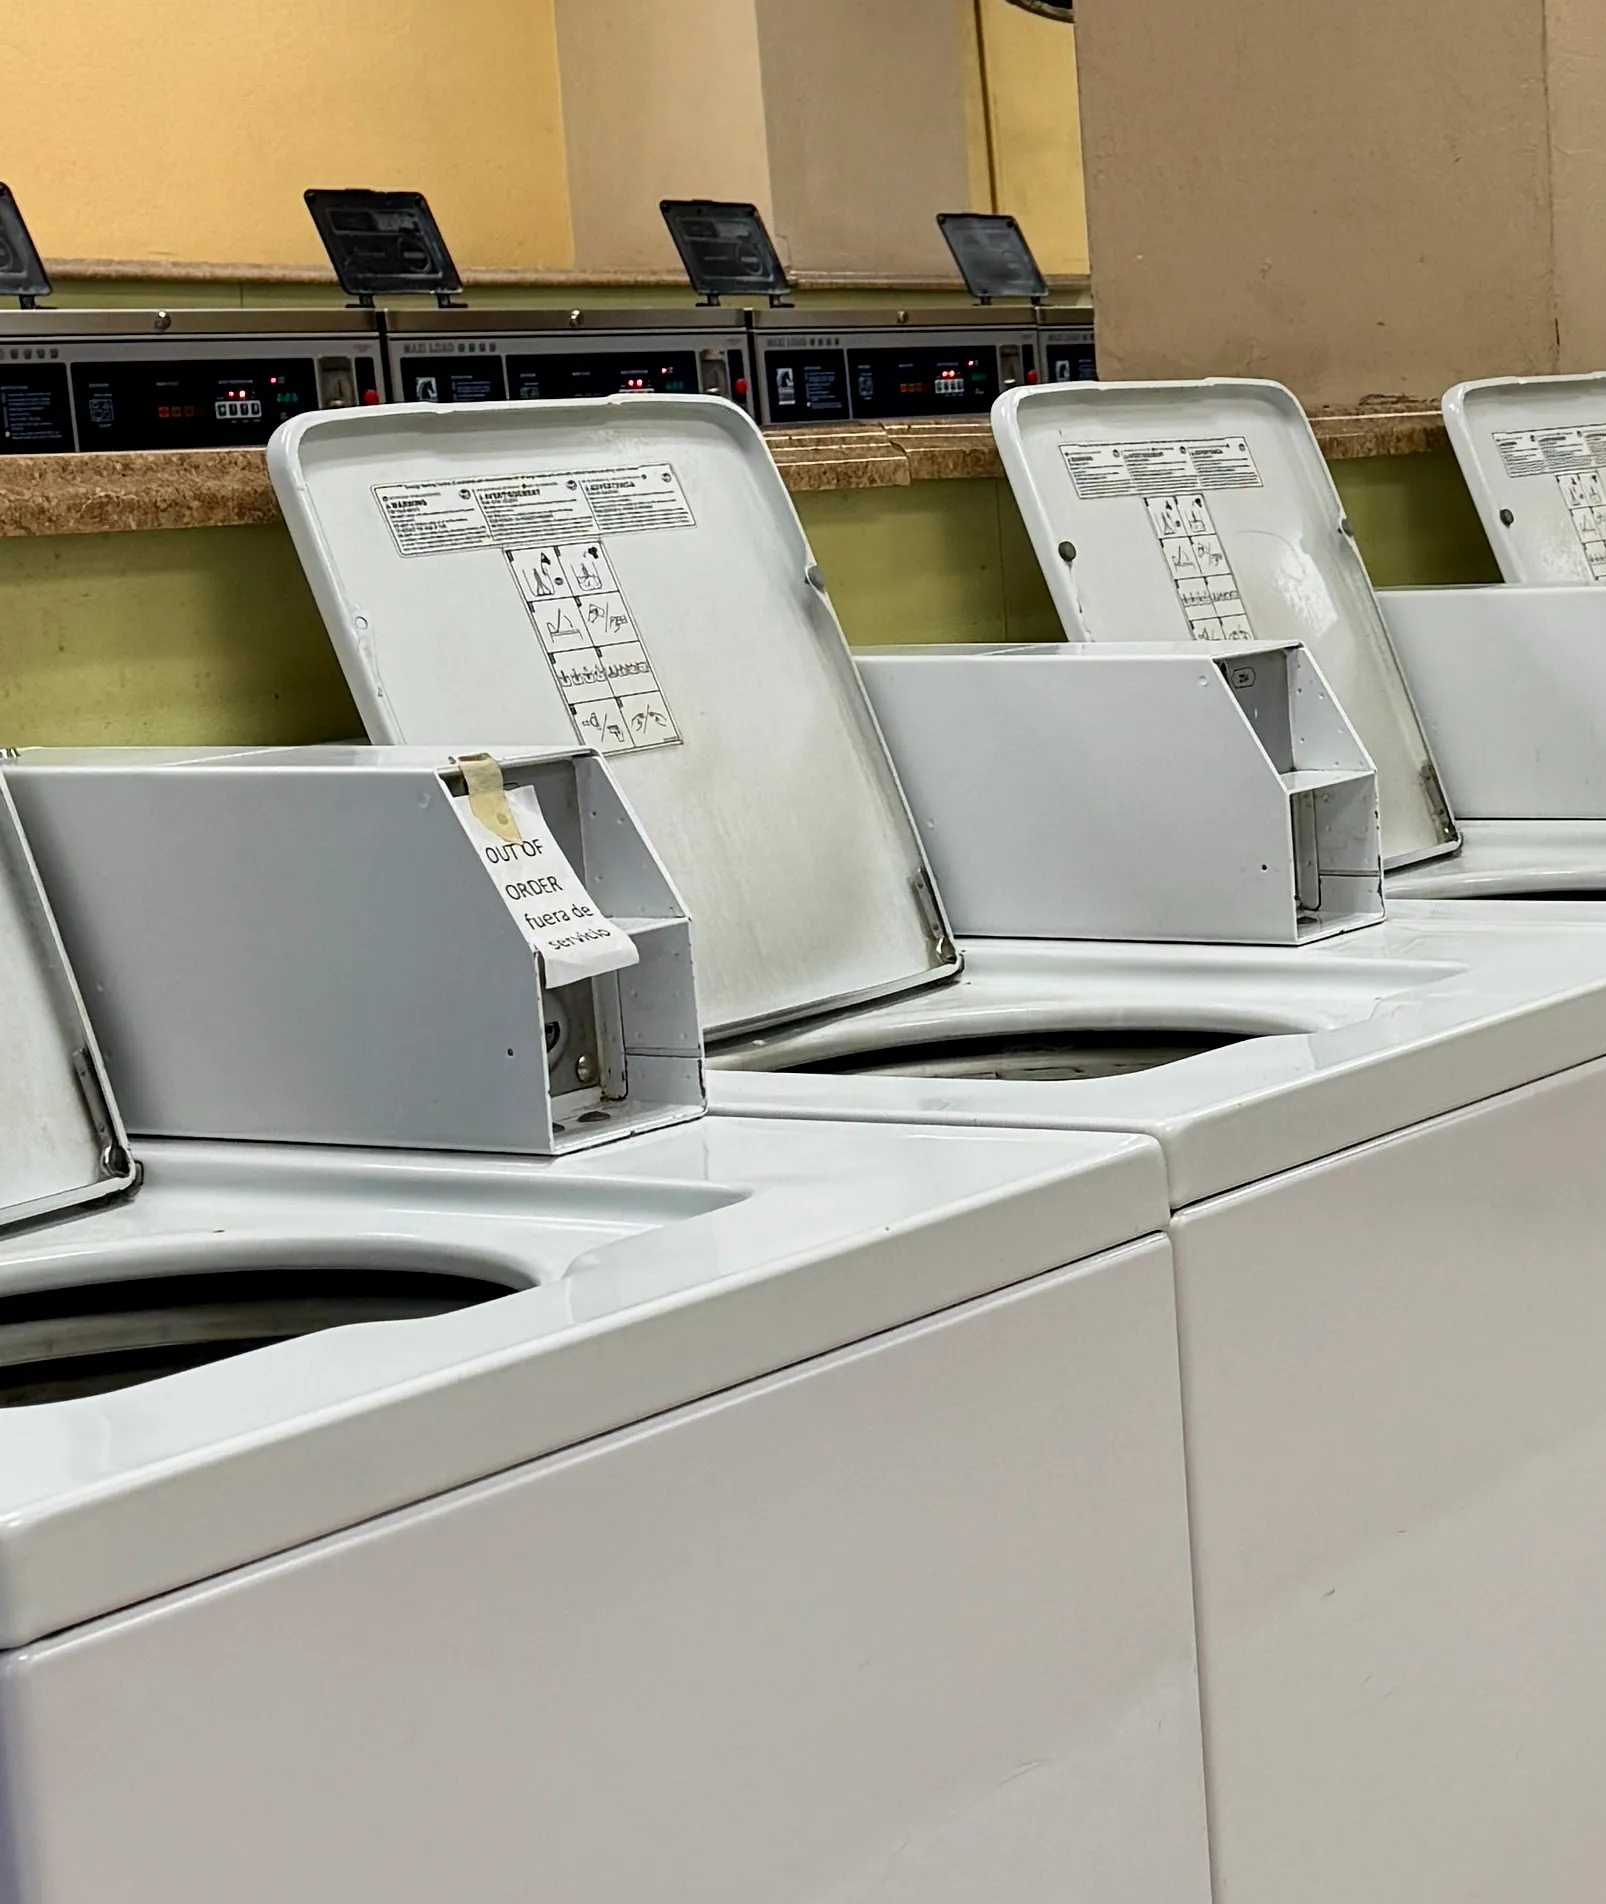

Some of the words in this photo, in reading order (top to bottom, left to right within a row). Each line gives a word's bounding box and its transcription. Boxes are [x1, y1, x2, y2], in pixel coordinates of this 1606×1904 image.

[485, 842, 521, 864] OUT
[521, 839, 544, 858] OF
[505, 875, 563, 901] ORDER
[523, 909, 570, 930] fuera
[572, 903, 595, 919] de
[548, 927, 612, 950] servicio
